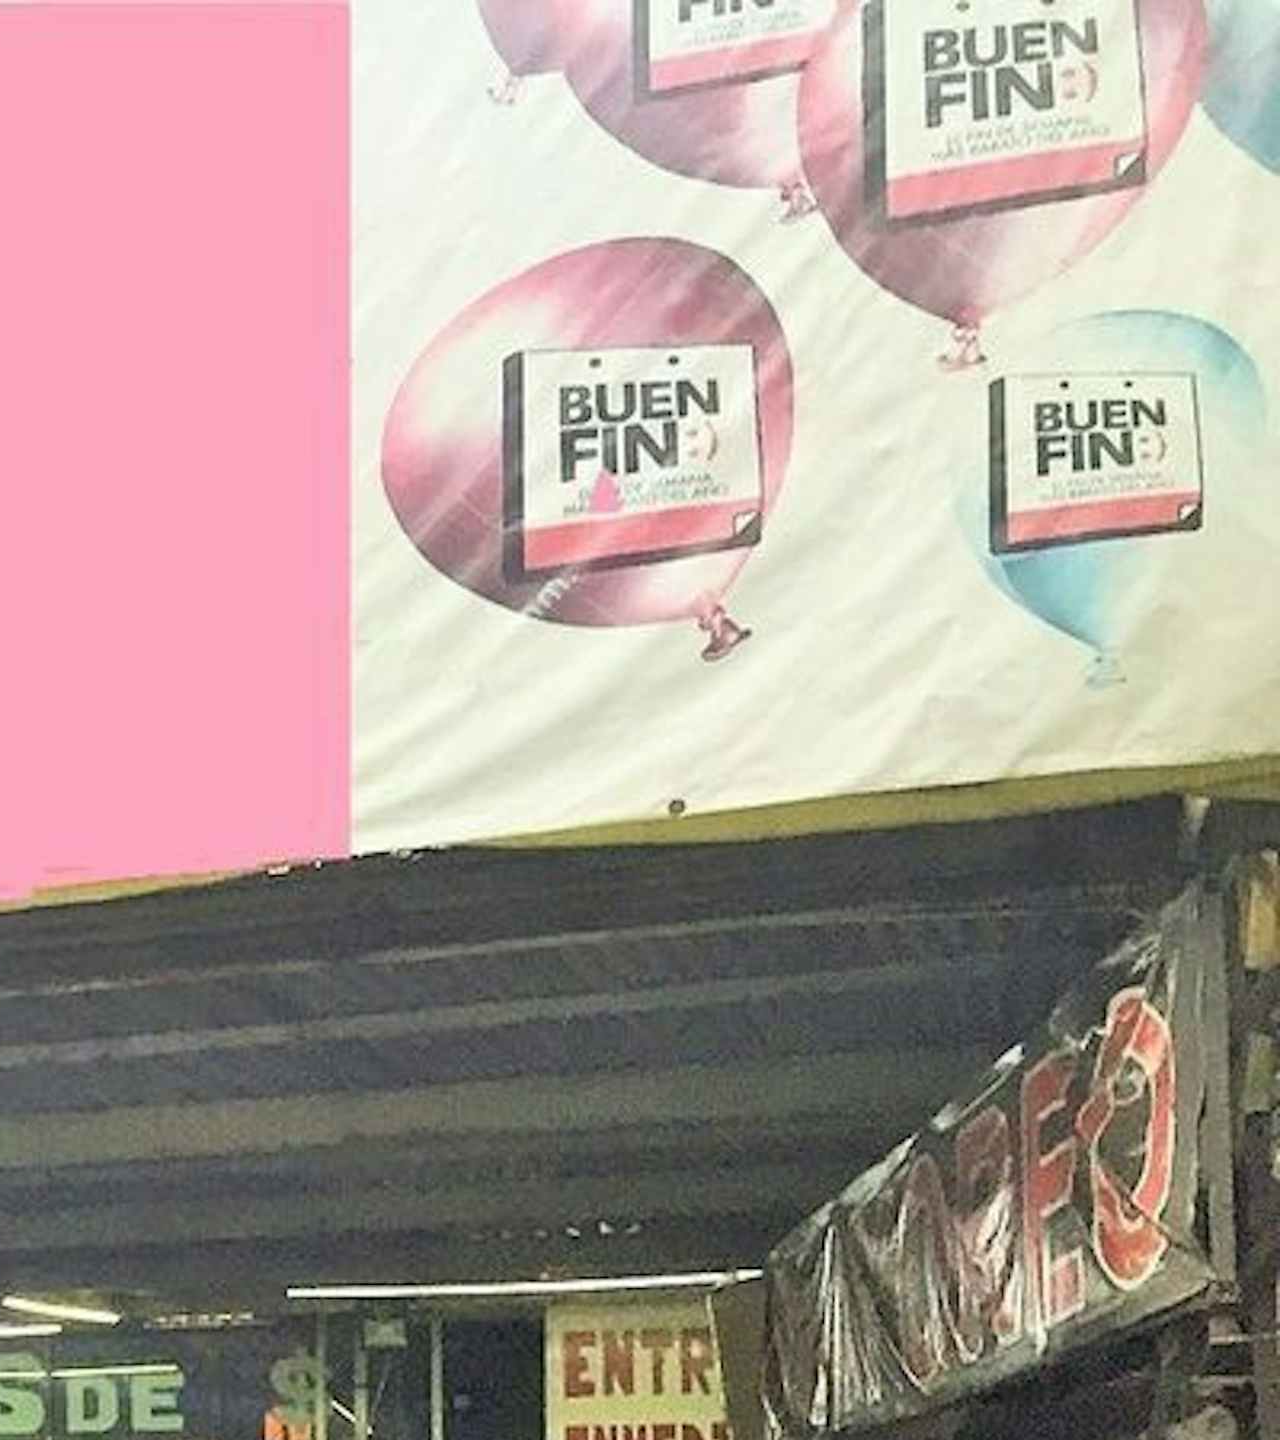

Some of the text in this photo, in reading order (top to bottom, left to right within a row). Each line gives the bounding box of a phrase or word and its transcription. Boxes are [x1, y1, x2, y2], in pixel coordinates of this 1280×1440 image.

[924, 18, 1099, 72] BUEN
[559, 378, 719, 425] BUEN
[1034, 398, 1167, 432] BUEN
[561, 1330, 715, 1398] ENTR
[64, 1367, 185, 1433] DE
